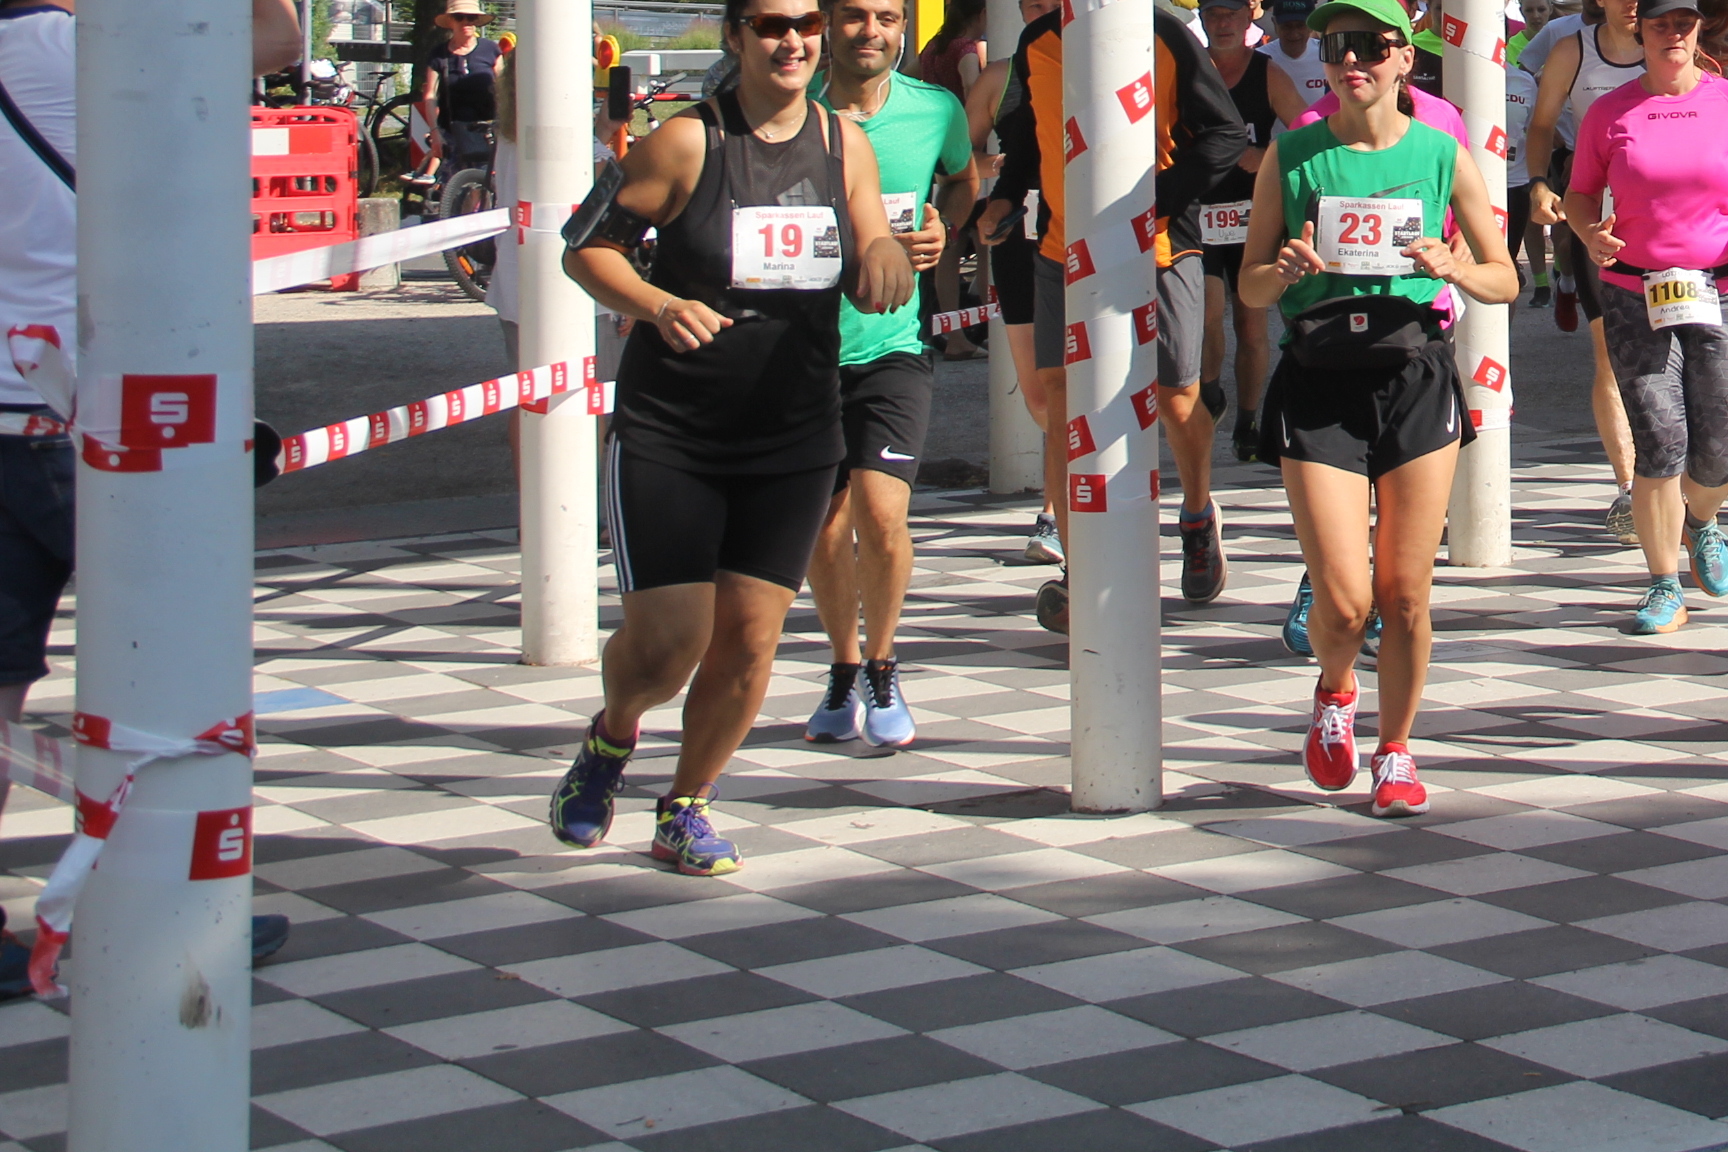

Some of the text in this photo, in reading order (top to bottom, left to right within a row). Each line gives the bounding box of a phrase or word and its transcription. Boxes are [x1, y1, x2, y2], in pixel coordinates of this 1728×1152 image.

[1282, 0, 1306, 9] BOSS
[1647, 111, 1698, 121] GIVOVA
[1340, 200, 1405, 211] Sparkassen Lauf
[755, 210, 825, 223] Sparkassen Lauf
[1203, 209, 1240, 229] 199
[1337, 212, 1382, 246] 23
[758, 223, 804, 259] 19
[1337, 247, 1380, 259] Ekaterina
[762, 262, 796, 272] Marina
[1649, 280, 1698, 304] 1108
[1660, 304, 1691, 315] Andrea
